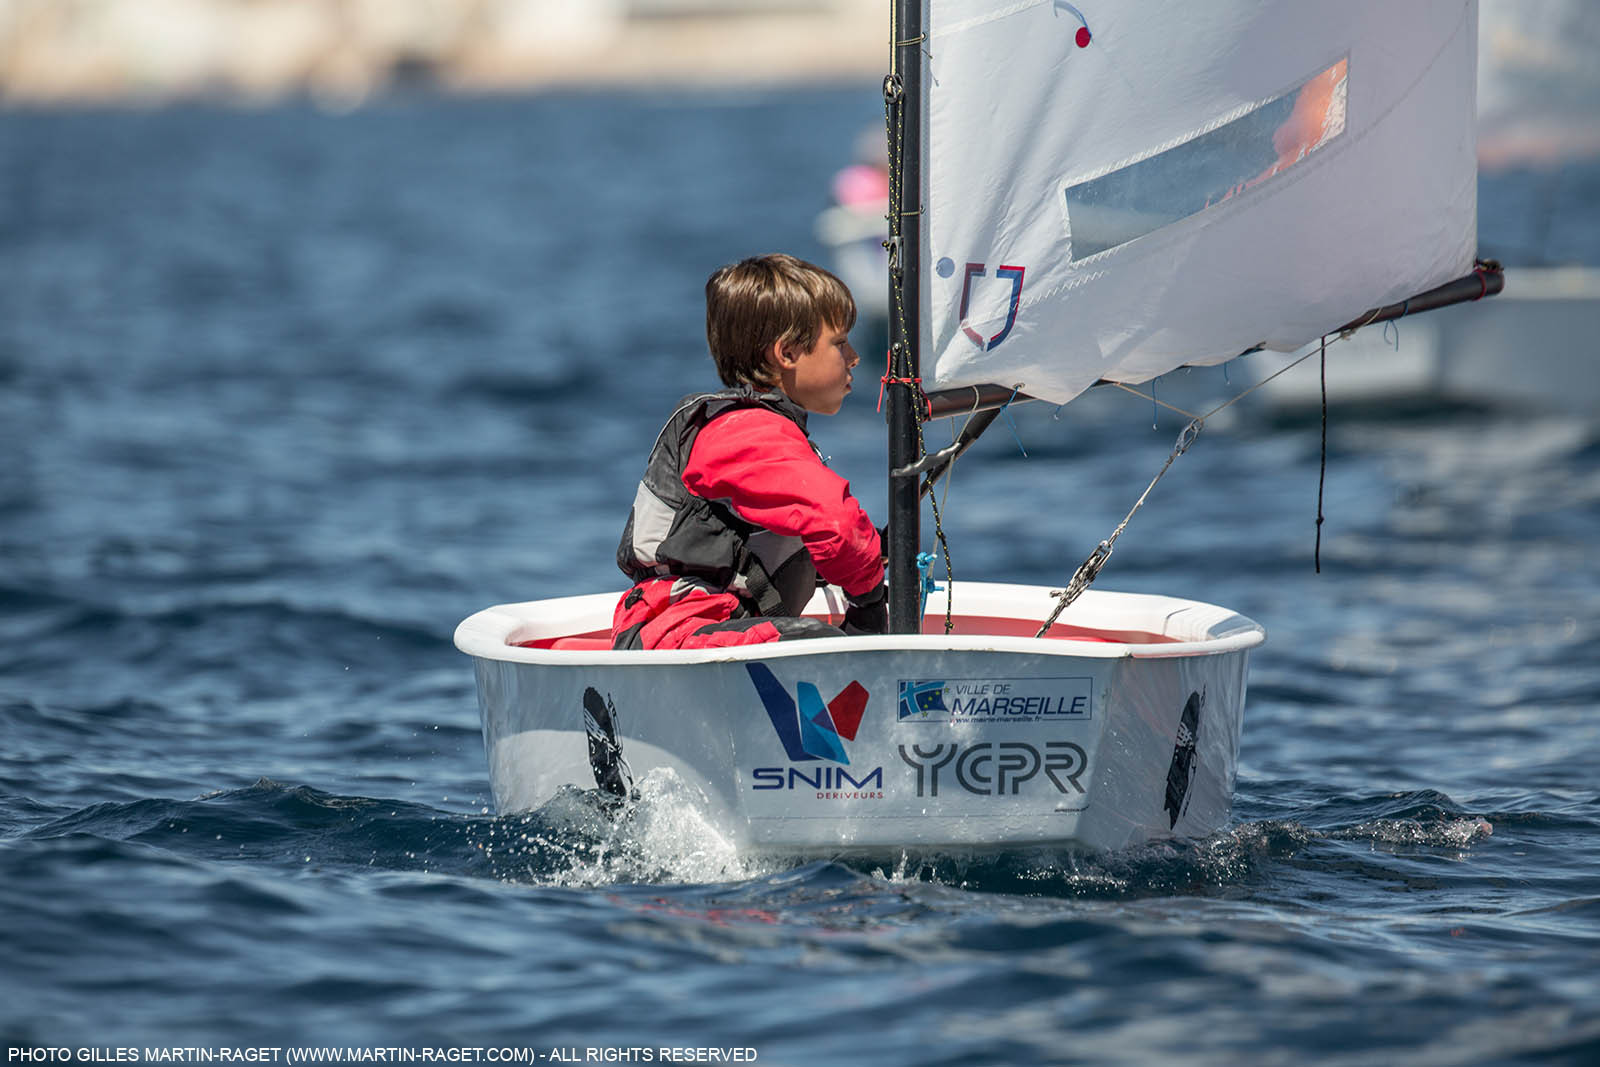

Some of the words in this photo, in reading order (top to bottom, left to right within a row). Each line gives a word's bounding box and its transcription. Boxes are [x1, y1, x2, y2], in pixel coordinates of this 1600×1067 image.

[955, 684, 990, 695] VILLE
[992, 684, 1012, 694] DE
[951, 696, 1087, 716] MARSEILLE
[752, 766, 883, 790] SNIM
[898, 742, 1087, 798] YCPR
[816, 791, 884, 800] DERIVEURS
